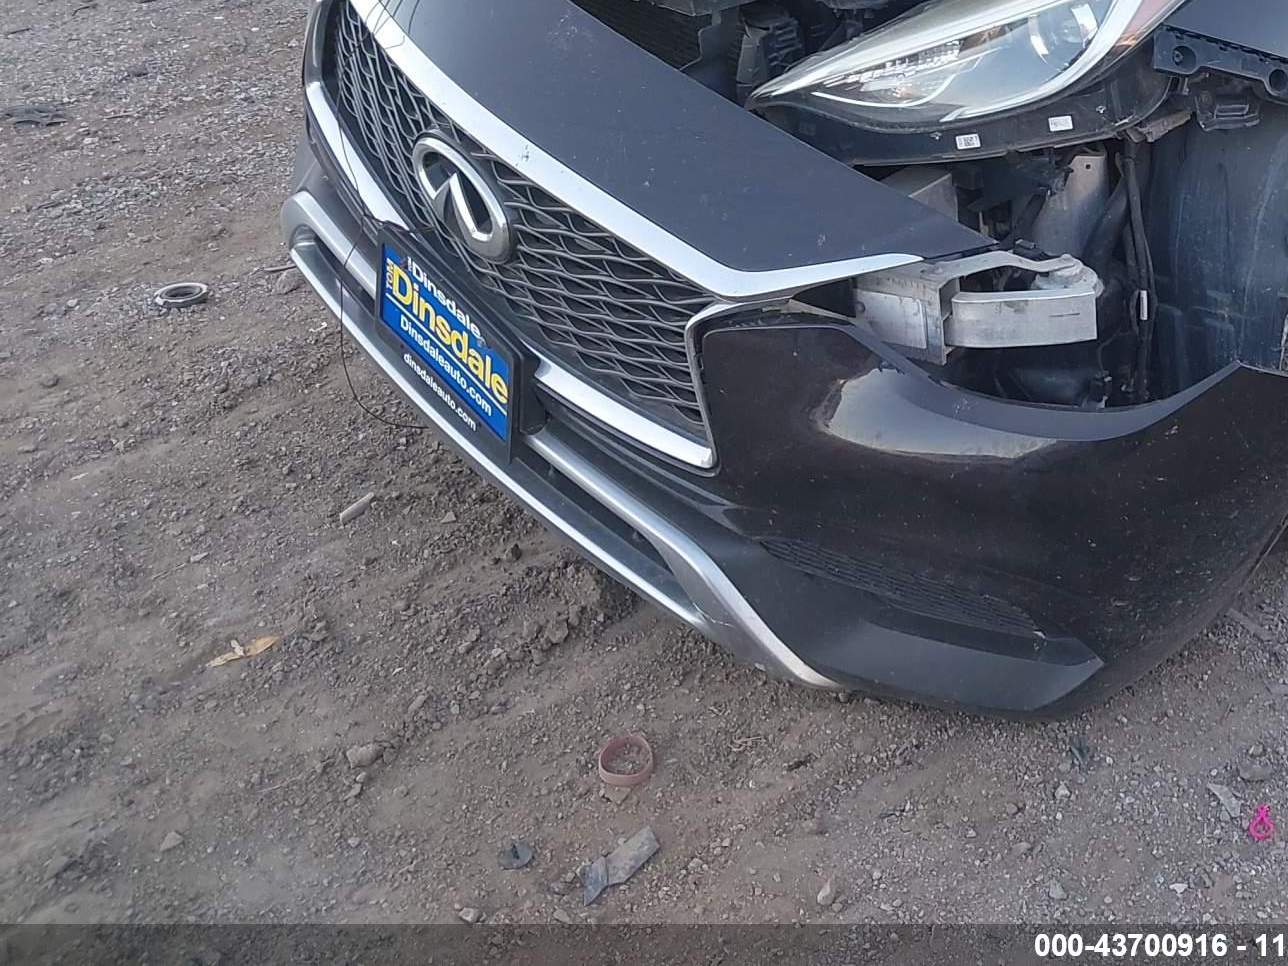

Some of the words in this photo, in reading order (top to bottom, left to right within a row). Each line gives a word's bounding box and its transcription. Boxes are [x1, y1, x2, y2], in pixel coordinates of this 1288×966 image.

[393, 264, 509, 405] Dinsdale
[411, 261, 481, 338] Dinsdale
[400, 313, 493, 417] Dinsdaleauto.com
[403, 352, 478, 432] dinsdaleauto.com
